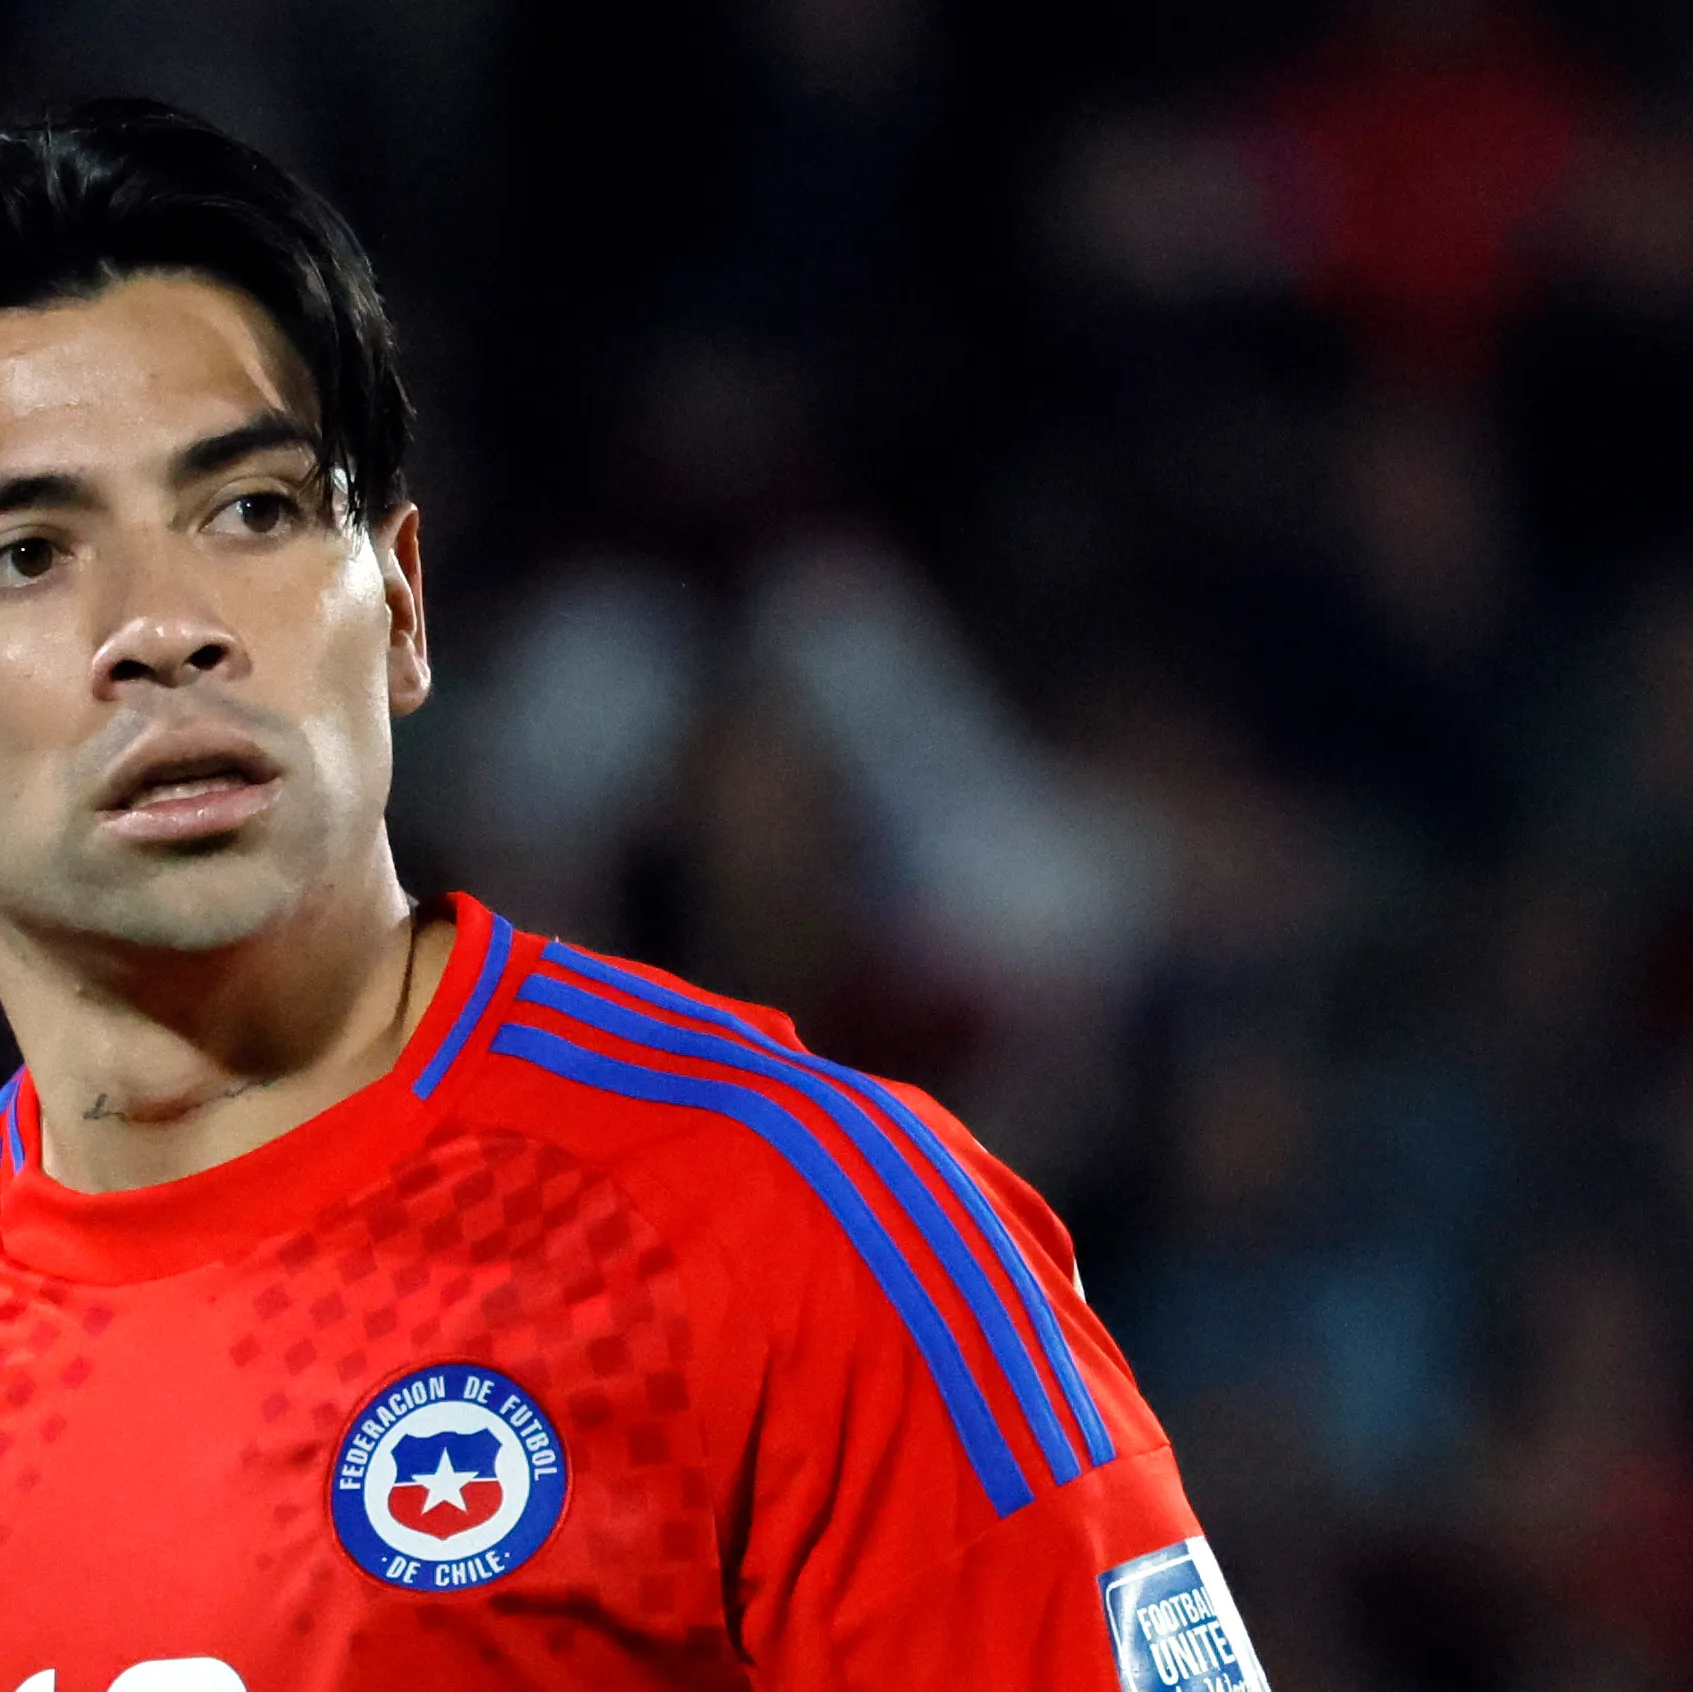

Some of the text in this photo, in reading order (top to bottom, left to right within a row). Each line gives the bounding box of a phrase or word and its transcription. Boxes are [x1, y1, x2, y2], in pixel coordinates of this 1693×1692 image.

[339, 1375, 558, 1491] FEDERACION DE FUTBOL
[386, 1550, 506, 1587] DE CHILE
